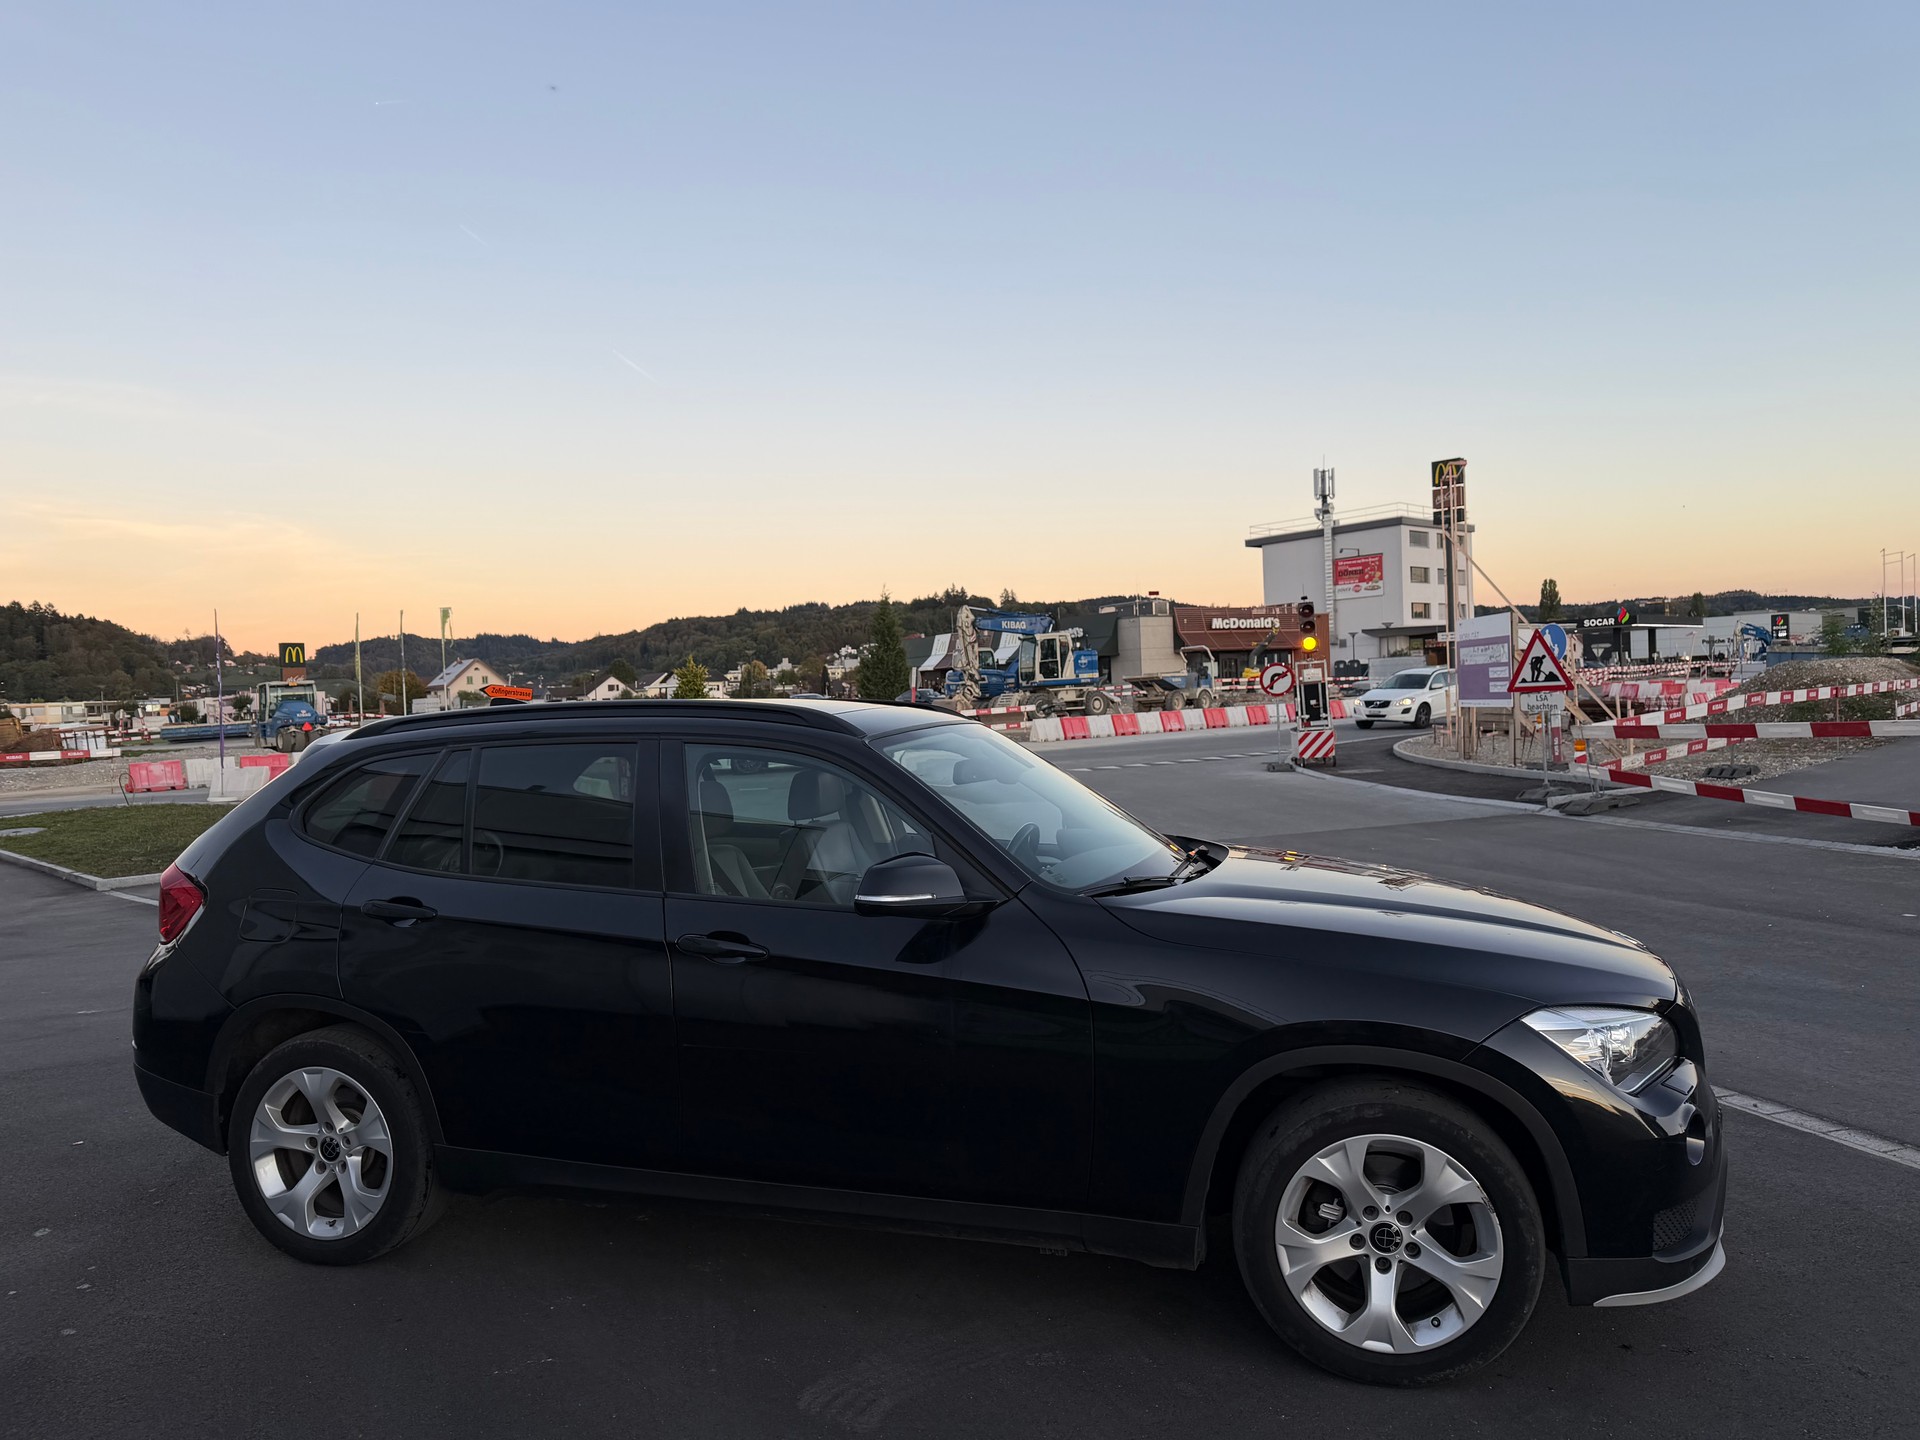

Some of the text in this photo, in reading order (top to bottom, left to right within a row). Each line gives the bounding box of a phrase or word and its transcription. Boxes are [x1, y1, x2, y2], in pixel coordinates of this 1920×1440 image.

[1001, 620, 1027, 629] KIBAG
[1211, 617, 1280, 629] McDonald's
[1583, 617, 1615, 627] SOCAR
[491, 687, 531, 697] Zofingerstrasse
[1535, 694, 1549, 702] LSA
[1527, 702, 1558, 710] beachten
[1669, 711, 1682, 719] KIBAG
[1692, 743, 1703, 751] KIBAG
[1649, 752, 1662, 761] KIBAG
